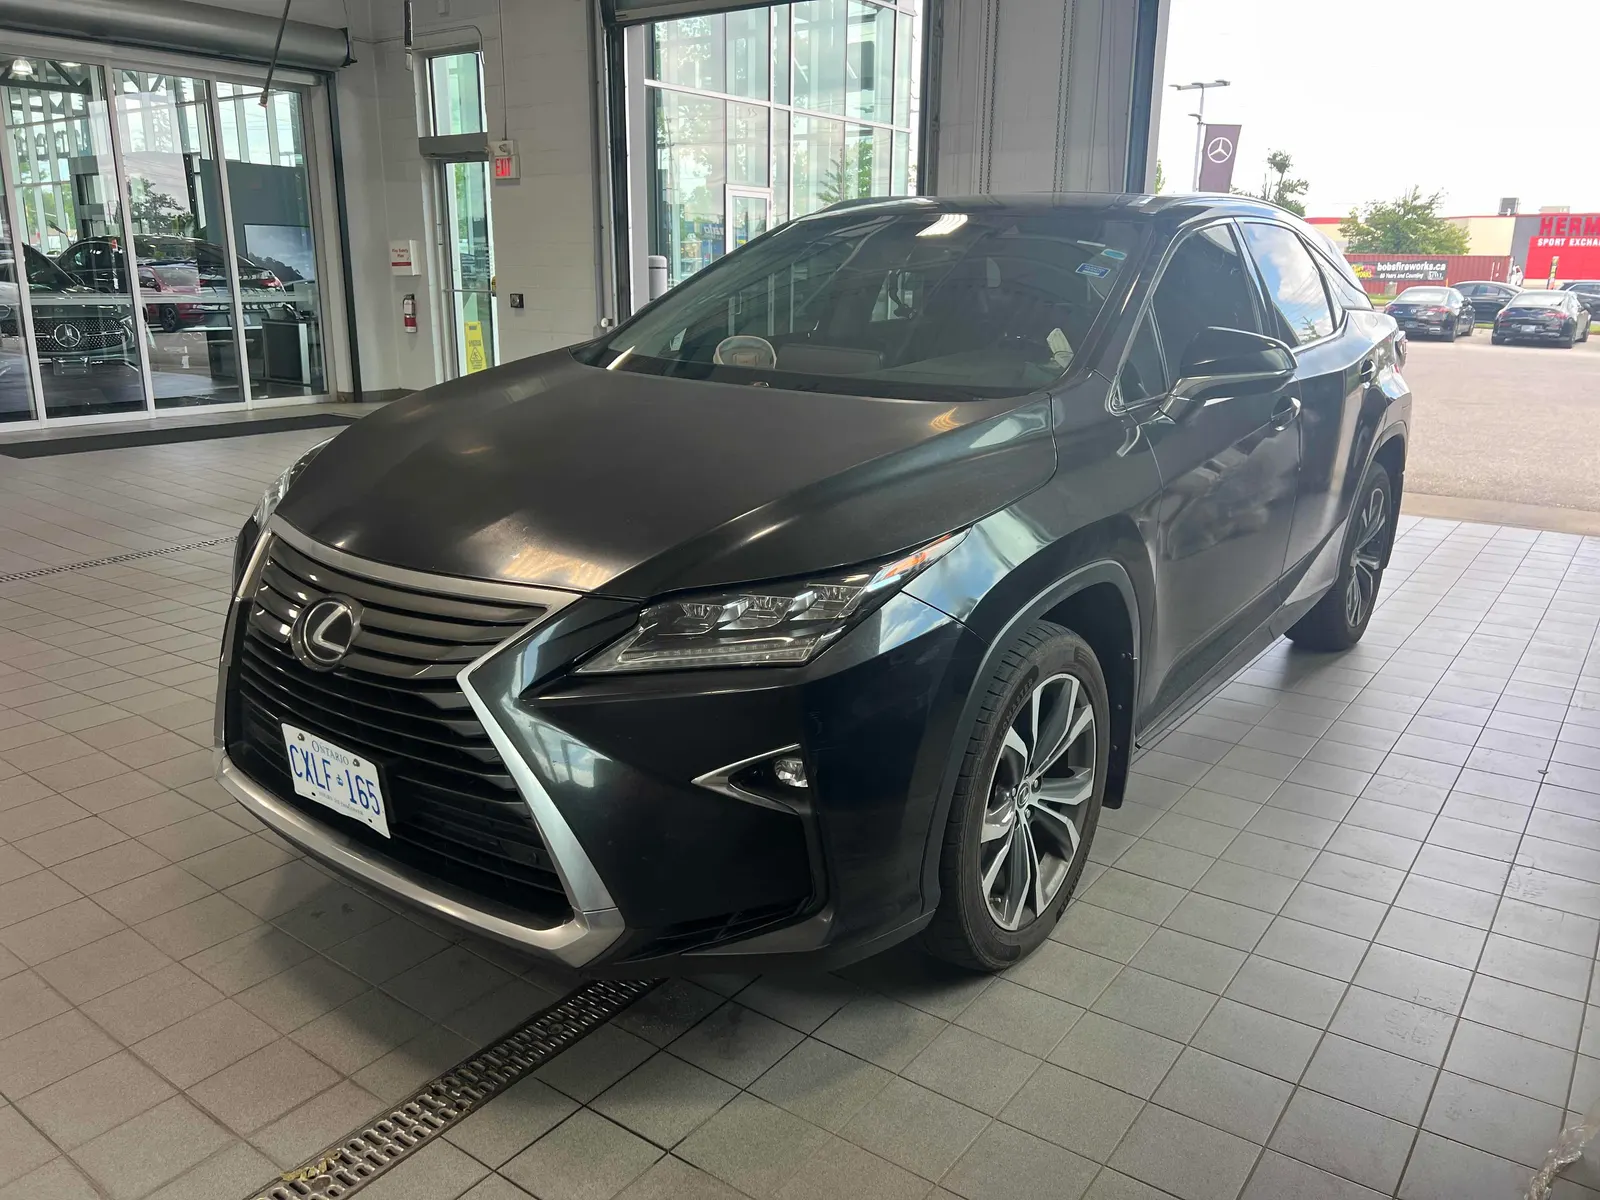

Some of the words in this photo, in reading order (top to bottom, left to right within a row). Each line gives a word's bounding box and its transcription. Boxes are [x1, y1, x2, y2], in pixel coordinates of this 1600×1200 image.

[495, 157, 512, 176] EXIT
[1539, 215, 1600, 236] HERM
[1537, 237, 1566, 247] SPORT
[1569, 237, 1600, 247] EXCHA
[1376, 261, 1446, 271] bobsfireworks.ca
[311, 740, 350, 766] ONTARIO
[289, 744, 331, 792] CXLF
[345, 769, 381, 815] 165
